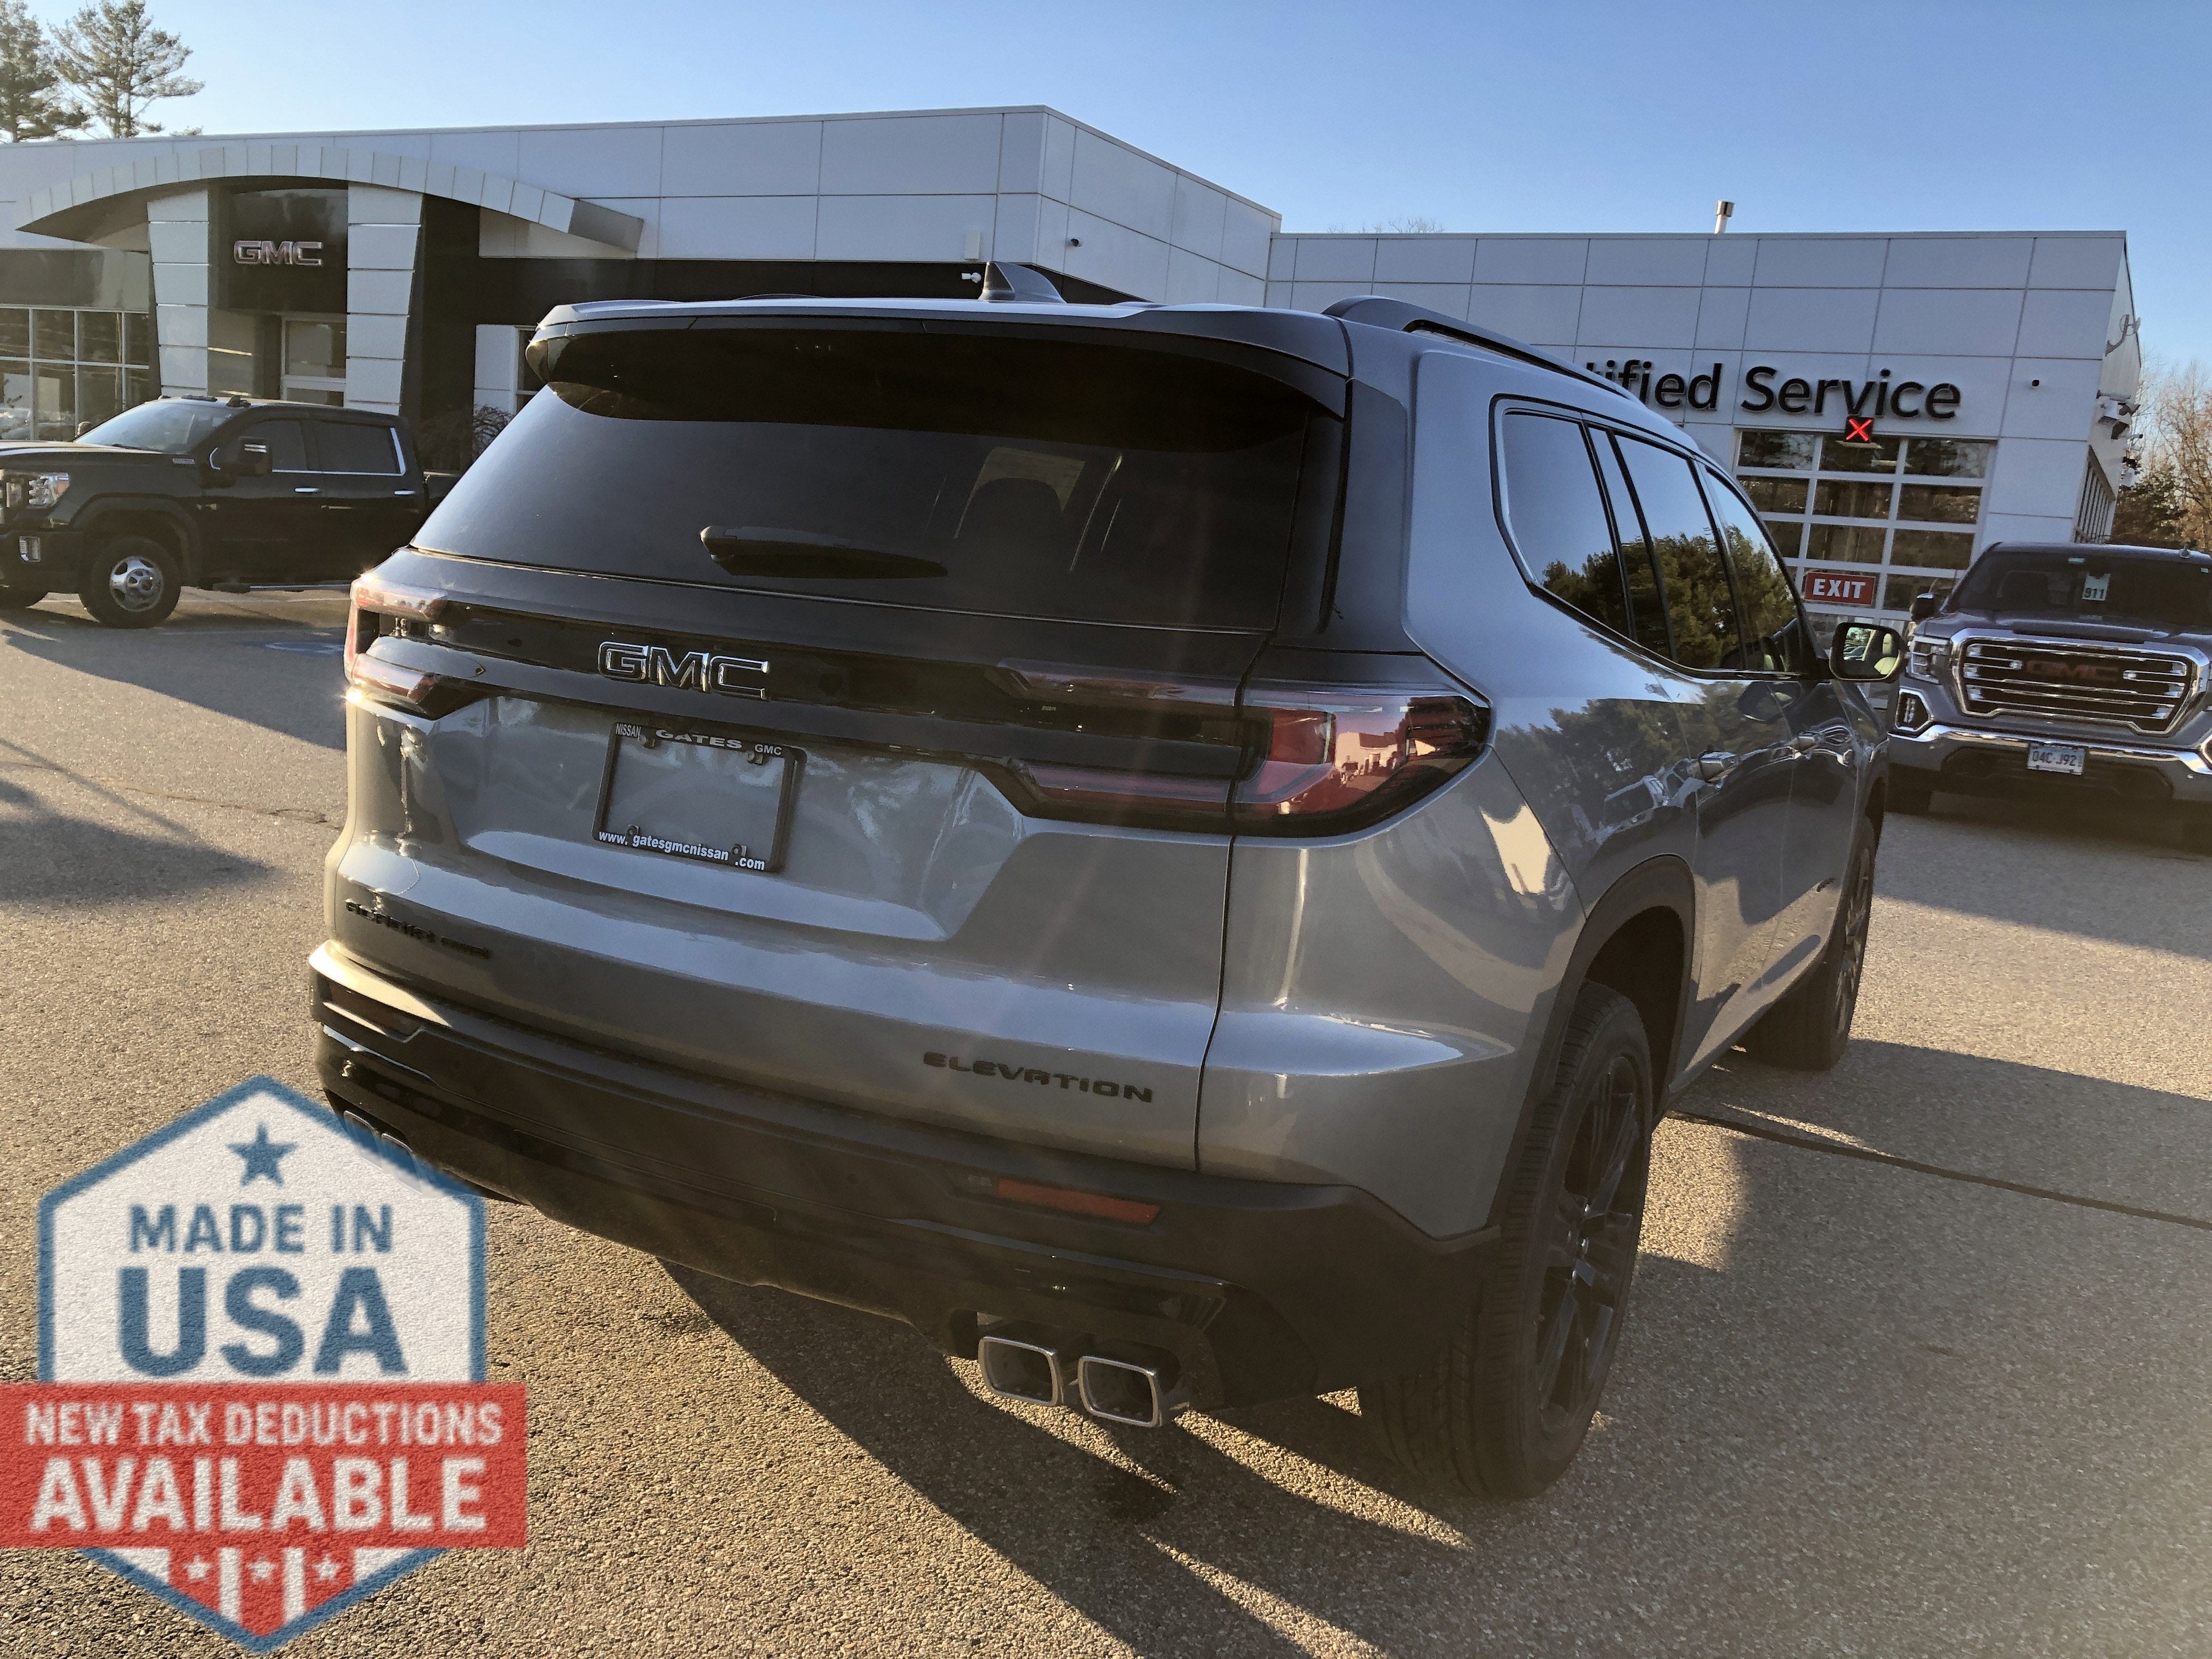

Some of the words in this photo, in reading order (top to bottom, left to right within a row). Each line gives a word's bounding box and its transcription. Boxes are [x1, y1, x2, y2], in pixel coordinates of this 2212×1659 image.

[234, 240, 322, 266] GMC
[1586, 359, 1723, 411] fied
[1741, 366, 1962, 420] Service
[1813, 578, 1865, 599] EXIT
[2084, 587, 2104, 599] 911
[597, 641, 769, 702] GMC
[2027, 660, 2119, 682] GMC
[616, 723, 641, 737] NISSAN
[656, 729, 742, 749] GATES
[754, 744, 782, 756] GMC
[599, 831, 628, 845] www.
[632, 834, 729, 861] gatesgmcnissan
[735, 857, 765, 871] .com
[923, 1051, 1153, 1103] ELEVATION
